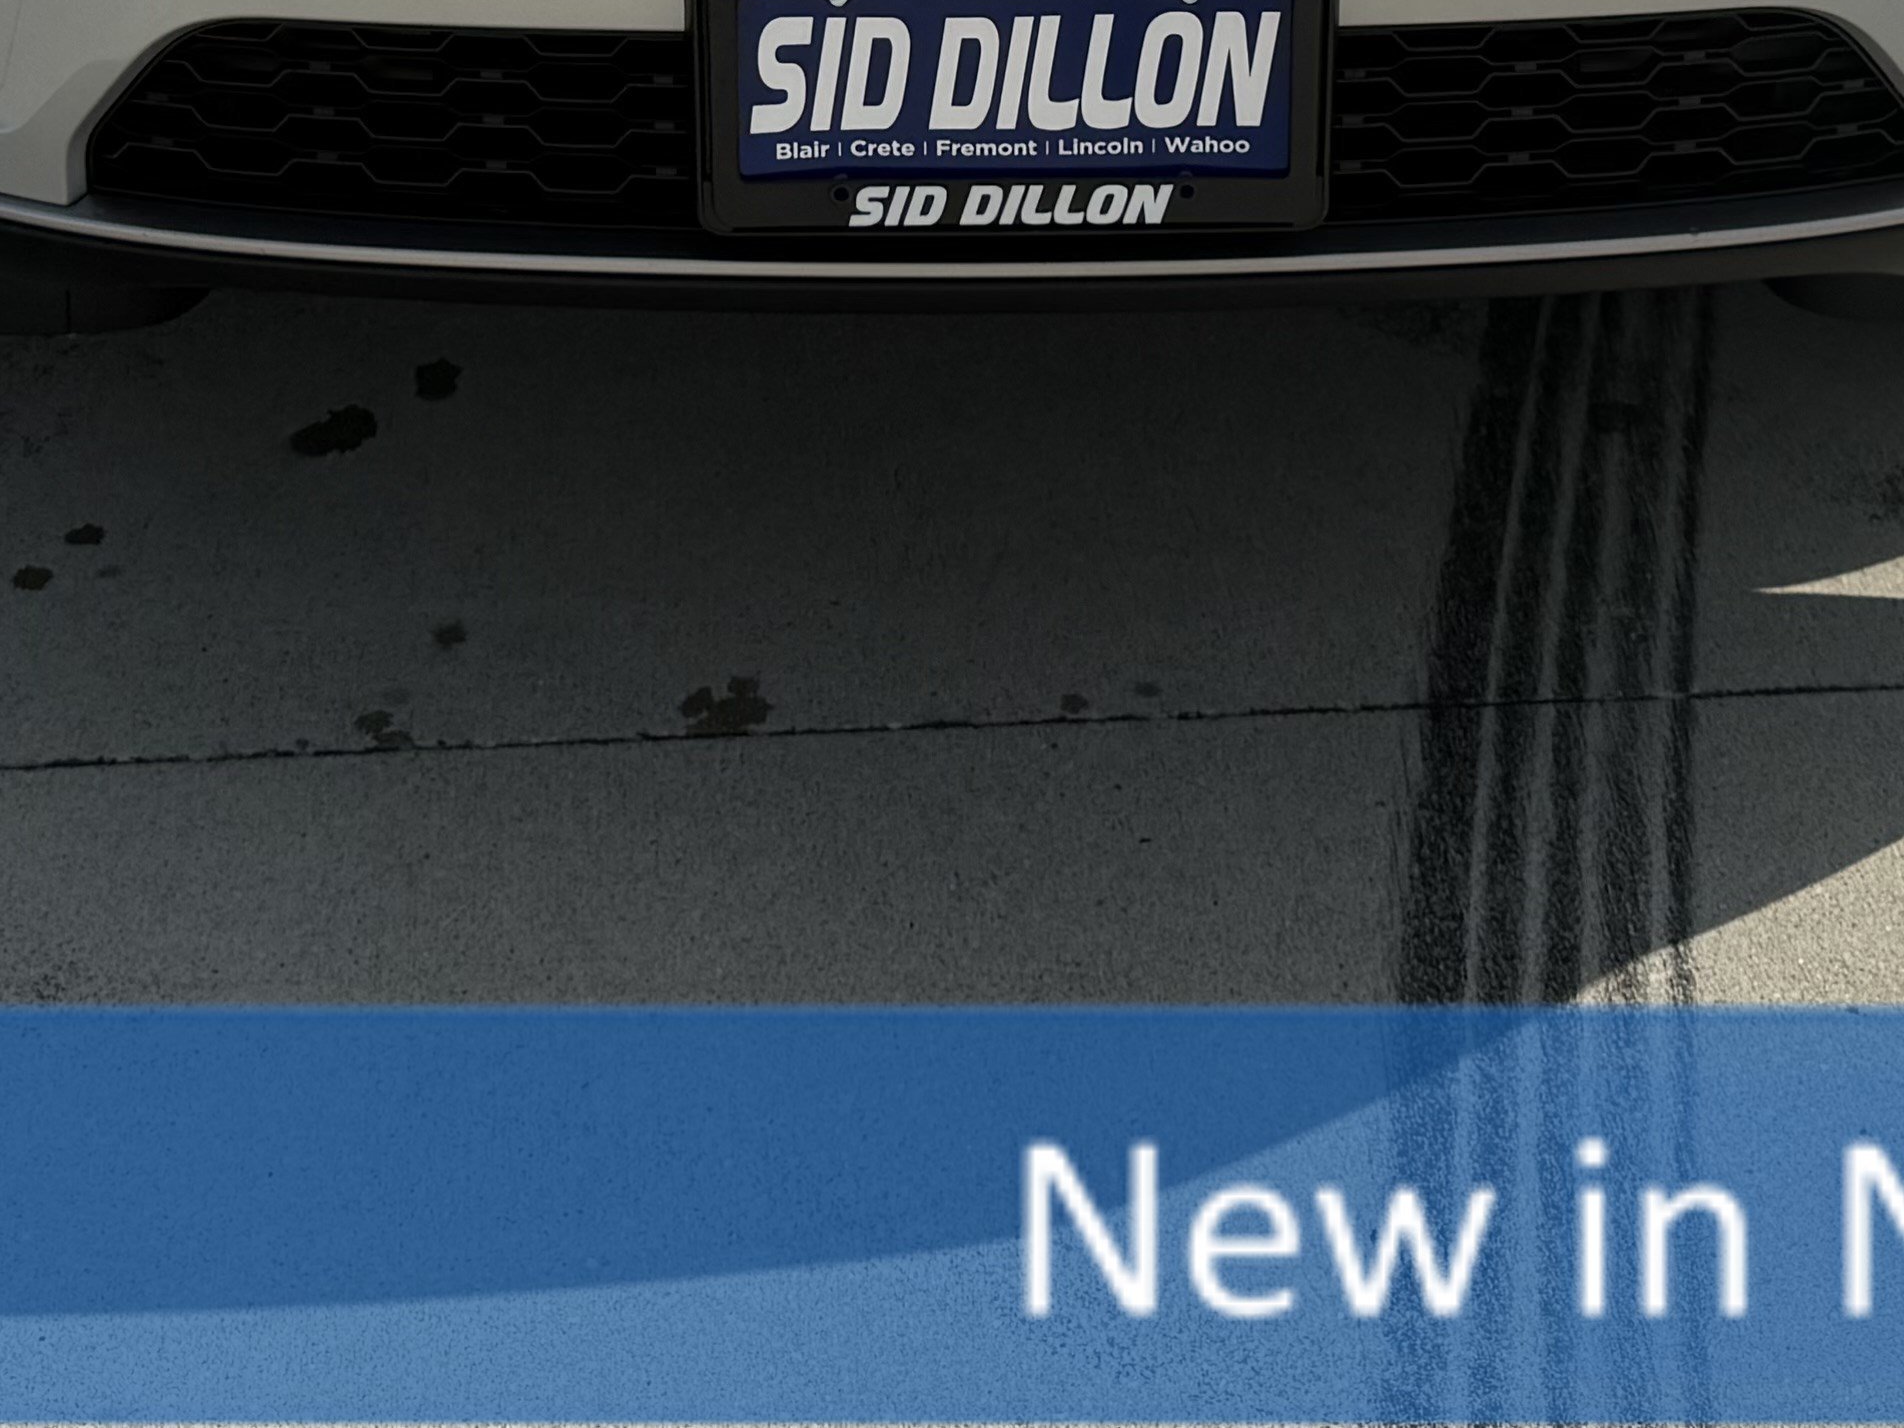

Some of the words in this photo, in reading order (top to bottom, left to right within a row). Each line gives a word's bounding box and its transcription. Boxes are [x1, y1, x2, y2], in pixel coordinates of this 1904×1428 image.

[749, 16, 911, 135] SID
[928, 10, 1281, 131] DILLON
[776, 140, 830, 160] Blair
[850, 139, 915, 157] Crete
[936, 139, 1038, 157] Fremont
[1058, 137, 1144, 156] Lincoln
[1164, 135, 1250, 154] Wahoo
[848, 185, 948, 227] SID
[959, 184, 1174, 226] DILLON
